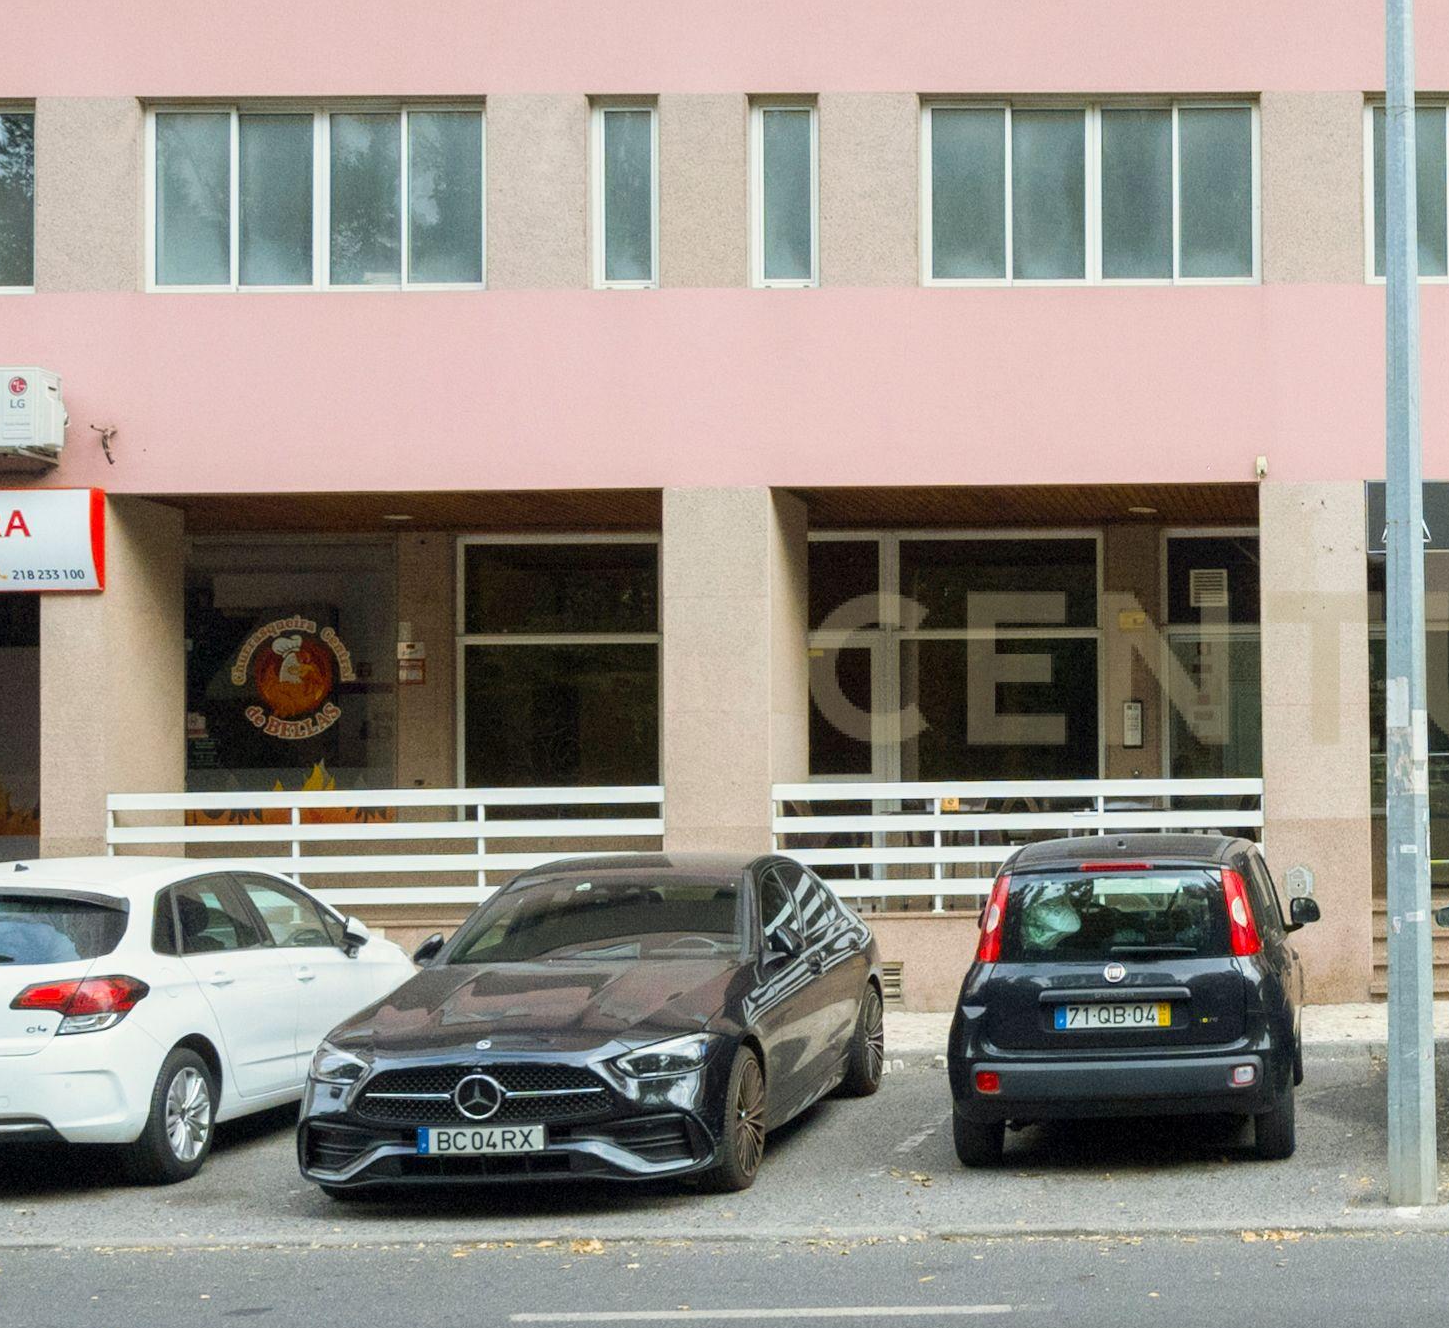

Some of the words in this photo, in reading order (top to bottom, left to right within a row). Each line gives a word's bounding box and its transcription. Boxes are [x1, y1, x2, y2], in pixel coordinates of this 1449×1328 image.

[9, 399, 26, 409] LG
[12, 570, 35, 580] 218
[38, 570, 60, 579] 233
[63, 569, 85, 579] 100
[231, 614, 317, 686] Churrasqueira
[320, 626, 356, 682] Central
[245, 705, 266, 727] de
[263, 702, 341, 740] BELLAS
